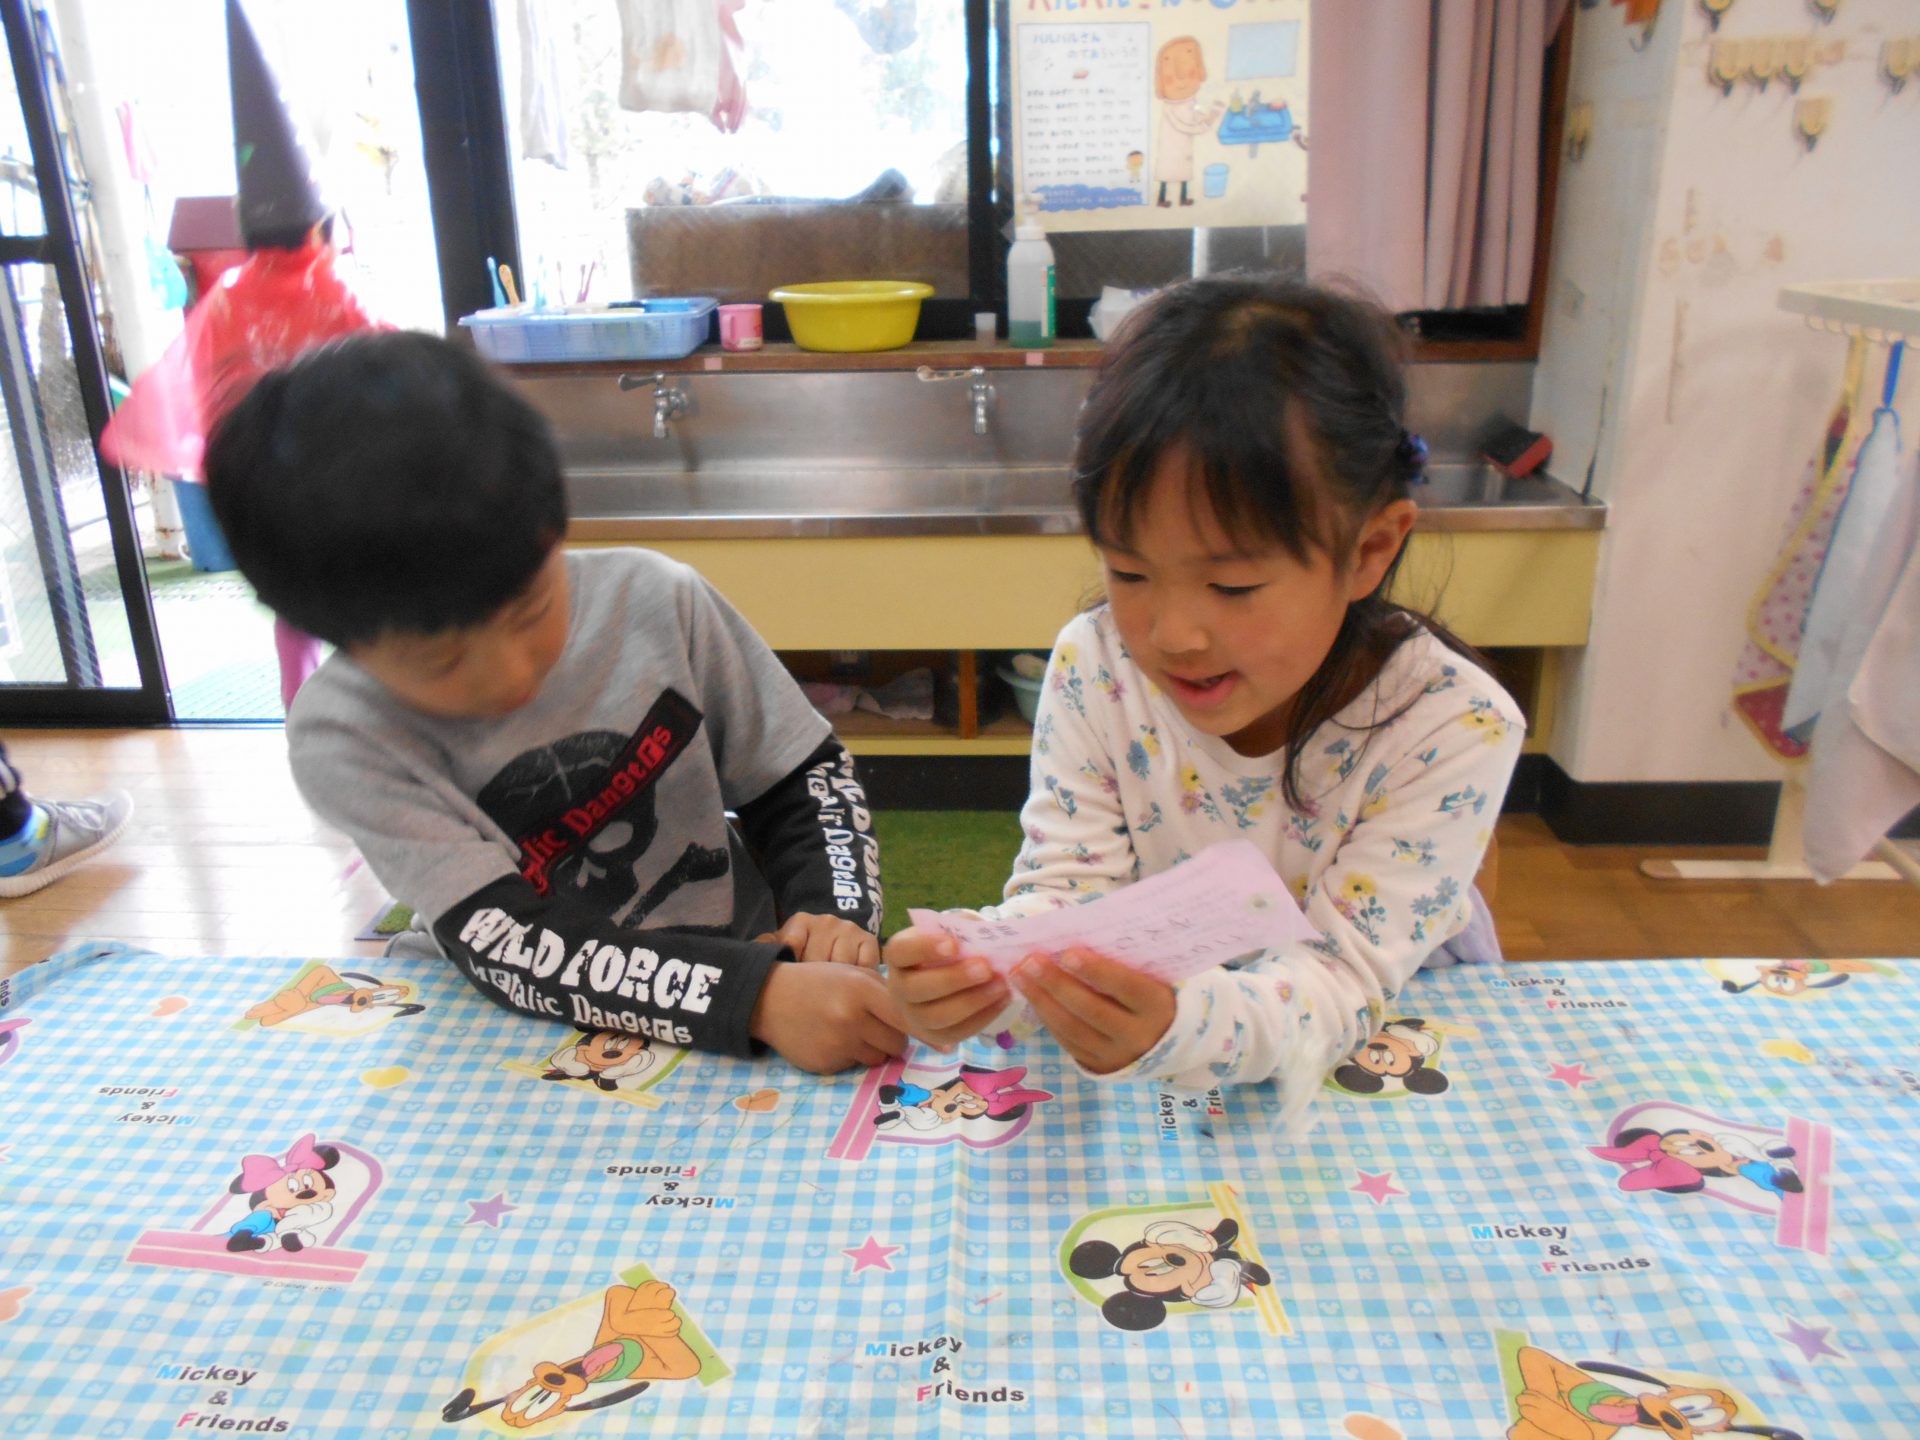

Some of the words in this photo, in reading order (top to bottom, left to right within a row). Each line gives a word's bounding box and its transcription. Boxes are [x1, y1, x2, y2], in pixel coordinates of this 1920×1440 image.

[561, 725, 672, 836] Dangers
[459, 907, 566, 978] WILD
[560, 939, 722, 1014] FORCE
[1493, 978, 1566, 987] Mickey
[1552, 988, 1566, 996] &
[1547, 1000, 1628, 1009] Friends
[569, 993, 693, 1044] Dangers
[98, 1086, 179, 1098] Friends
[141, 1101, 156, 1110] &
[1182, 1098, 1198, 1108] &
[1206, 1086, 1223, 1115] Frie
[117, 1113, 194, 1125] Mickey
[1159, 1093, 1179, 1141] Mickey
[606, 1165, 697, 1177] Friends
[663, 1181, 679, 1191] &
[645, 1194, 735, 1208] Mickey
[1471, 1224, 1567, 1239] Mickey
[1549, 1244, 1568, 1256] &
[1542, 1257, 1651, 1272] Friends
[865, 1336, 963, 1357] Mickey
[933, 1356, 951, 1373] &
[156, 1364, 258, 1386] Mickey
[208, 1390, 229, 1405] &
[917, 1379, 1025, 1403] Friends
[176, 1411, 290, 1433] Friends
